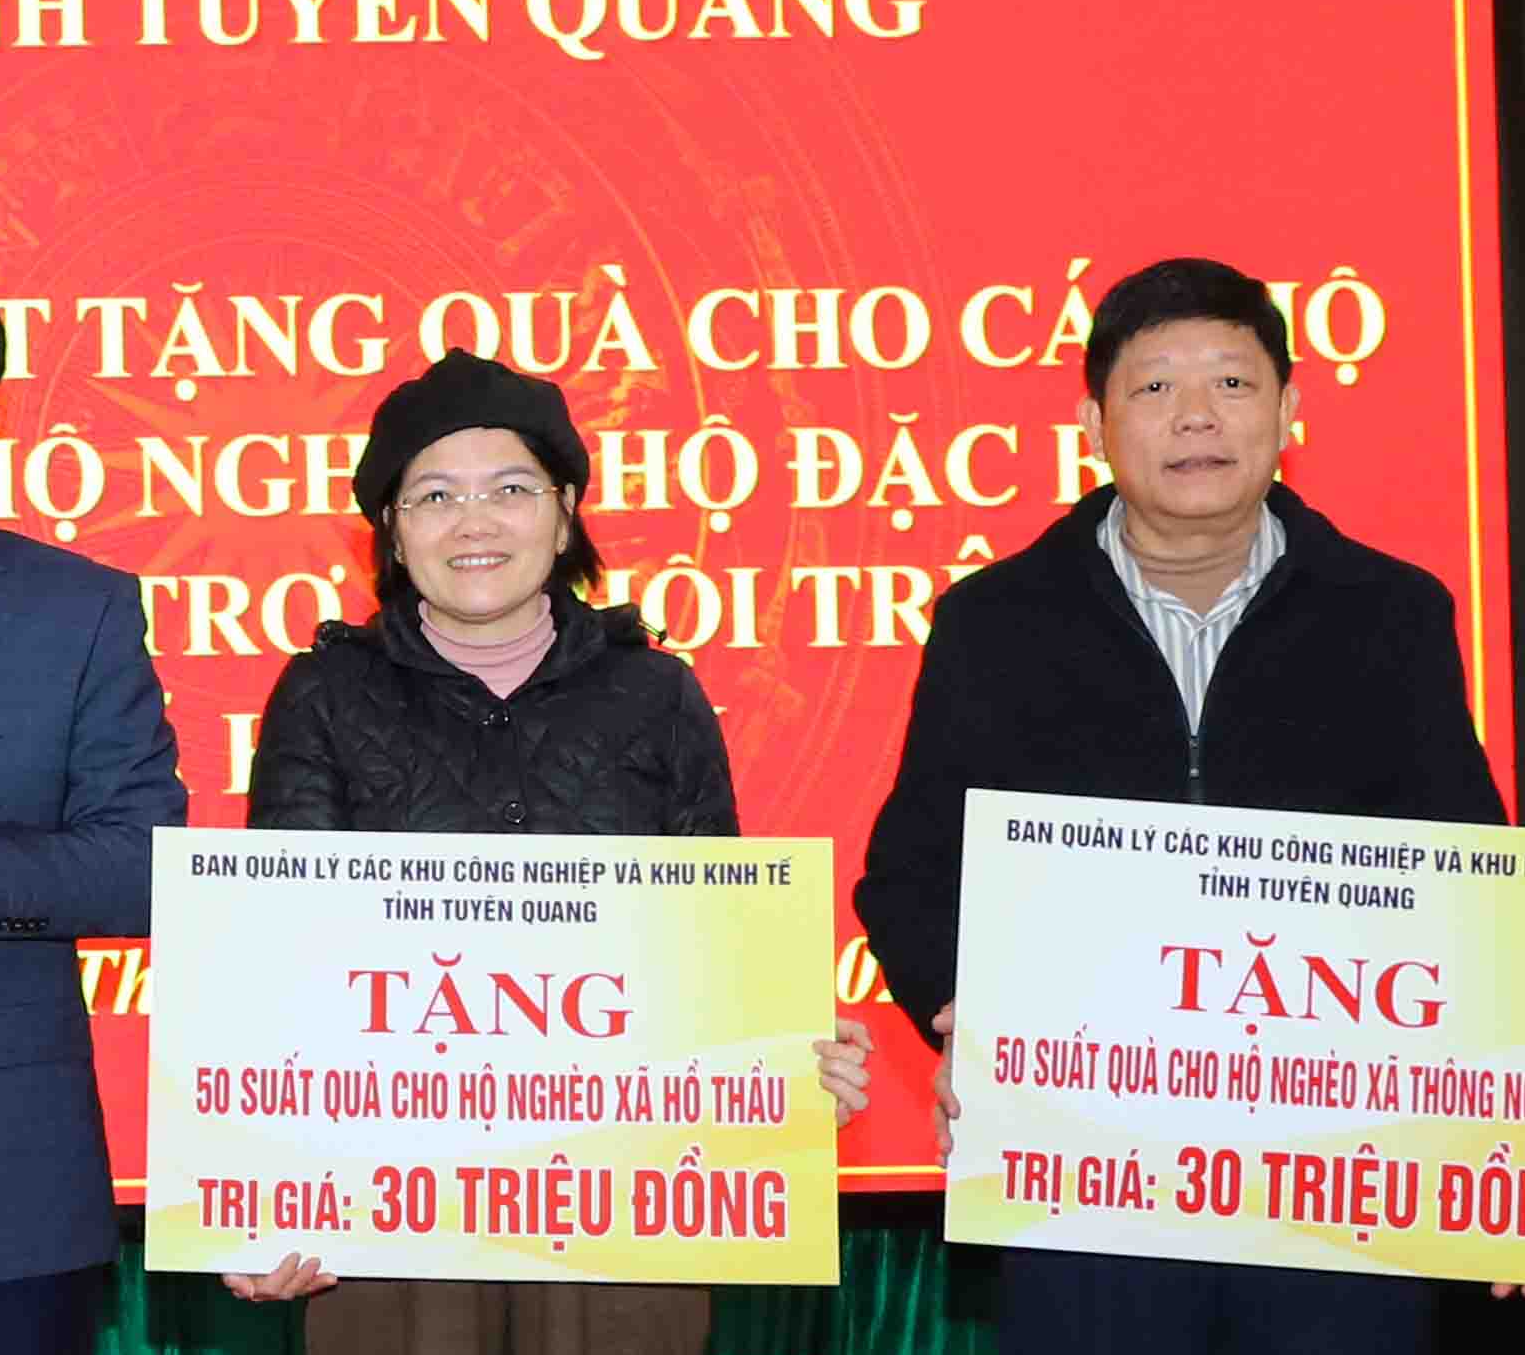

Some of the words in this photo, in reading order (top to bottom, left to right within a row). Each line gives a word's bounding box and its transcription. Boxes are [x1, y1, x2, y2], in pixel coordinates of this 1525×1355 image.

[76, 282, 390, 401] TẶNG
[419, 265, 659, 374] QUÀ
[687, 284, 932, 372] CHO
[960, 256, 1088, 368] CÁ
[602, 414, 760, 534] HỘ
[787, 413, 1017, 531] ĐẶC
[1007, 818, 1053, 845] BAN
[1062, 817, 1123, 850] QUẢN
[1132, 826, 1157, 852] LÝ
[1165, 826, 1211, 856] CÁC
[1217, 834, 1264, 859] KHU
[1271, 833, 1333, 865] CÔNG
[1341, 840, 1426, 874] NGHIỆP
[1434, 842, 1463, 873] VÀ
[1470, 852, 1517, 876] KHU
[1199, 869, 1251, 900] TỈNH
[1258, 875, 1331, 904] TUYÊN
[1338, 883, 1415, 910] QUANG
[442, 893, 513, 922] TUYÊN
[521, 899, 597, 924] QUANG
[349, 952, 633, 1054] TẶNG
[1160, 931, 1447, 1036] TẶNG
[196, 1065, 230, 1116] 50
[241, 1050, 314, 1117] SUẤT
[324, 1059, 381, 1122] QUÀ
[392, 1071, 448, 1120] CHO
[460, 1062, 496, 1131] HỘ
[508, 1063, 603, 1123] NGHÈO
[616, 1065, 653, 1123] XÃ
[995, 1036, 1026, 1085] 50
[1034, 1023, 1100, 1089] SUẤT
[1108, 1034, 1158, 1097] QUÀ
[1167, 1048, 1218, 1099] CHO
[1228, 1042, 1261, 1115] HỘ
[1271, 1049, 1356, 1110] NGHÈO
[1366, 1055, 1400, 1112] XÃ
[1409, 1058, 1494, 1119] THÔNG
[198, 1178, 258, 1240] TRỊ
[275, 1171, 351, 1231] GIÁ:
[372, 1166, 436, 1234] 30
[456, 1154, 612, 1251] TRIỆU
[632, 1147, 786, 1239] ĐỒNG
[1002, 1150, 1062, 1216] TRỊ
[1078, 1149, 1156, 1210] GIÁ:
[1176, 1146, 1241, 1216] 30
[1262, 1143, 1419, 1242] TRIỆU
